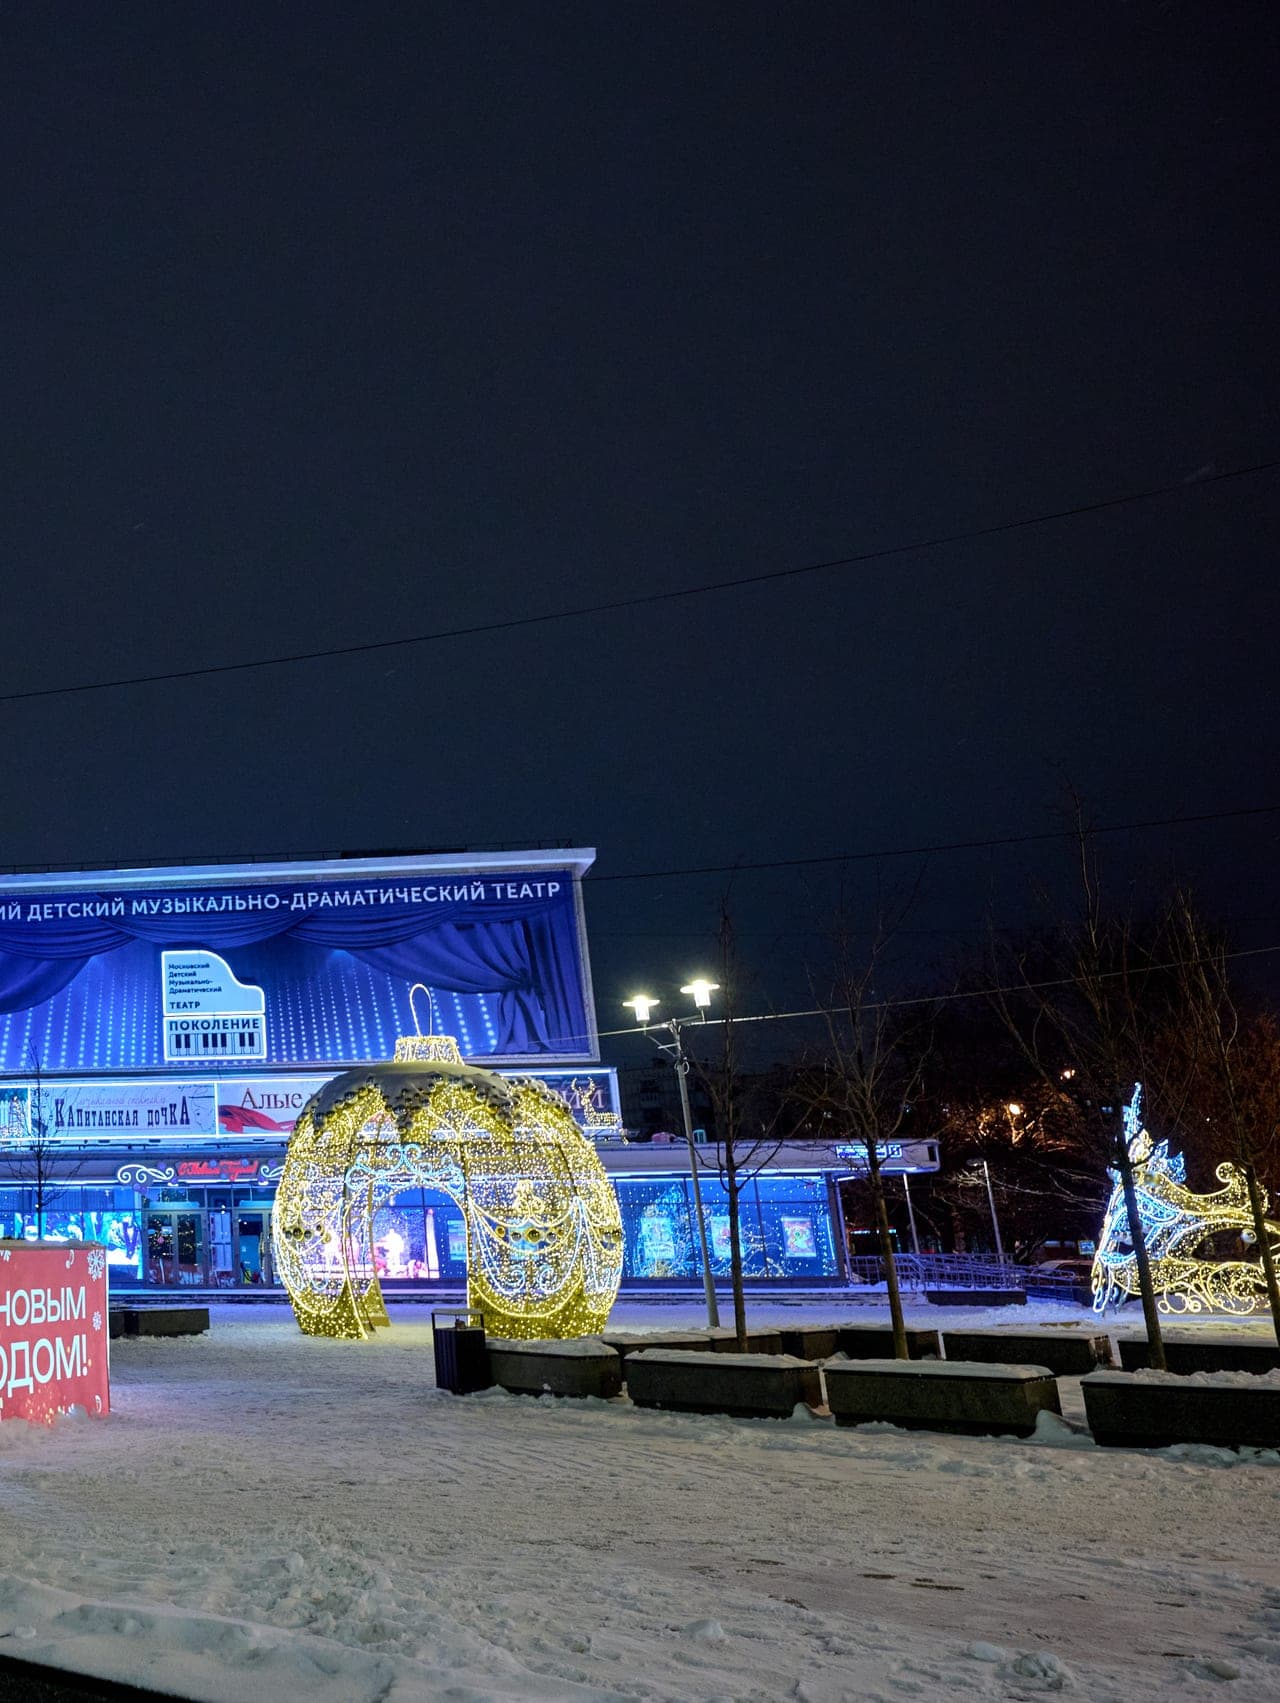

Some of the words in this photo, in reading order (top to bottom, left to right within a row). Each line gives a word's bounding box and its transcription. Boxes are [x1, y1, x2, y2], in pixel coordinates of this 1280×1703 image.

[27, 897, 124, 922] ДЕТСКИЙ
[132, 881, 486, 916] МУЗЫКАЛЬНО-ДРАМАТИЧЕСКИЙ
[491, 881, 561, 900] ТЕАТР
[168, 962, 210, 970] Московский
[168, 986, 222, 994] Драматический
[170, 1001, 201, 1009] ТЕАТР
[169, 1018, 260, 1031] ПОКОЛЕНИЕ
[241, 1087, 304, 1109] Алые
